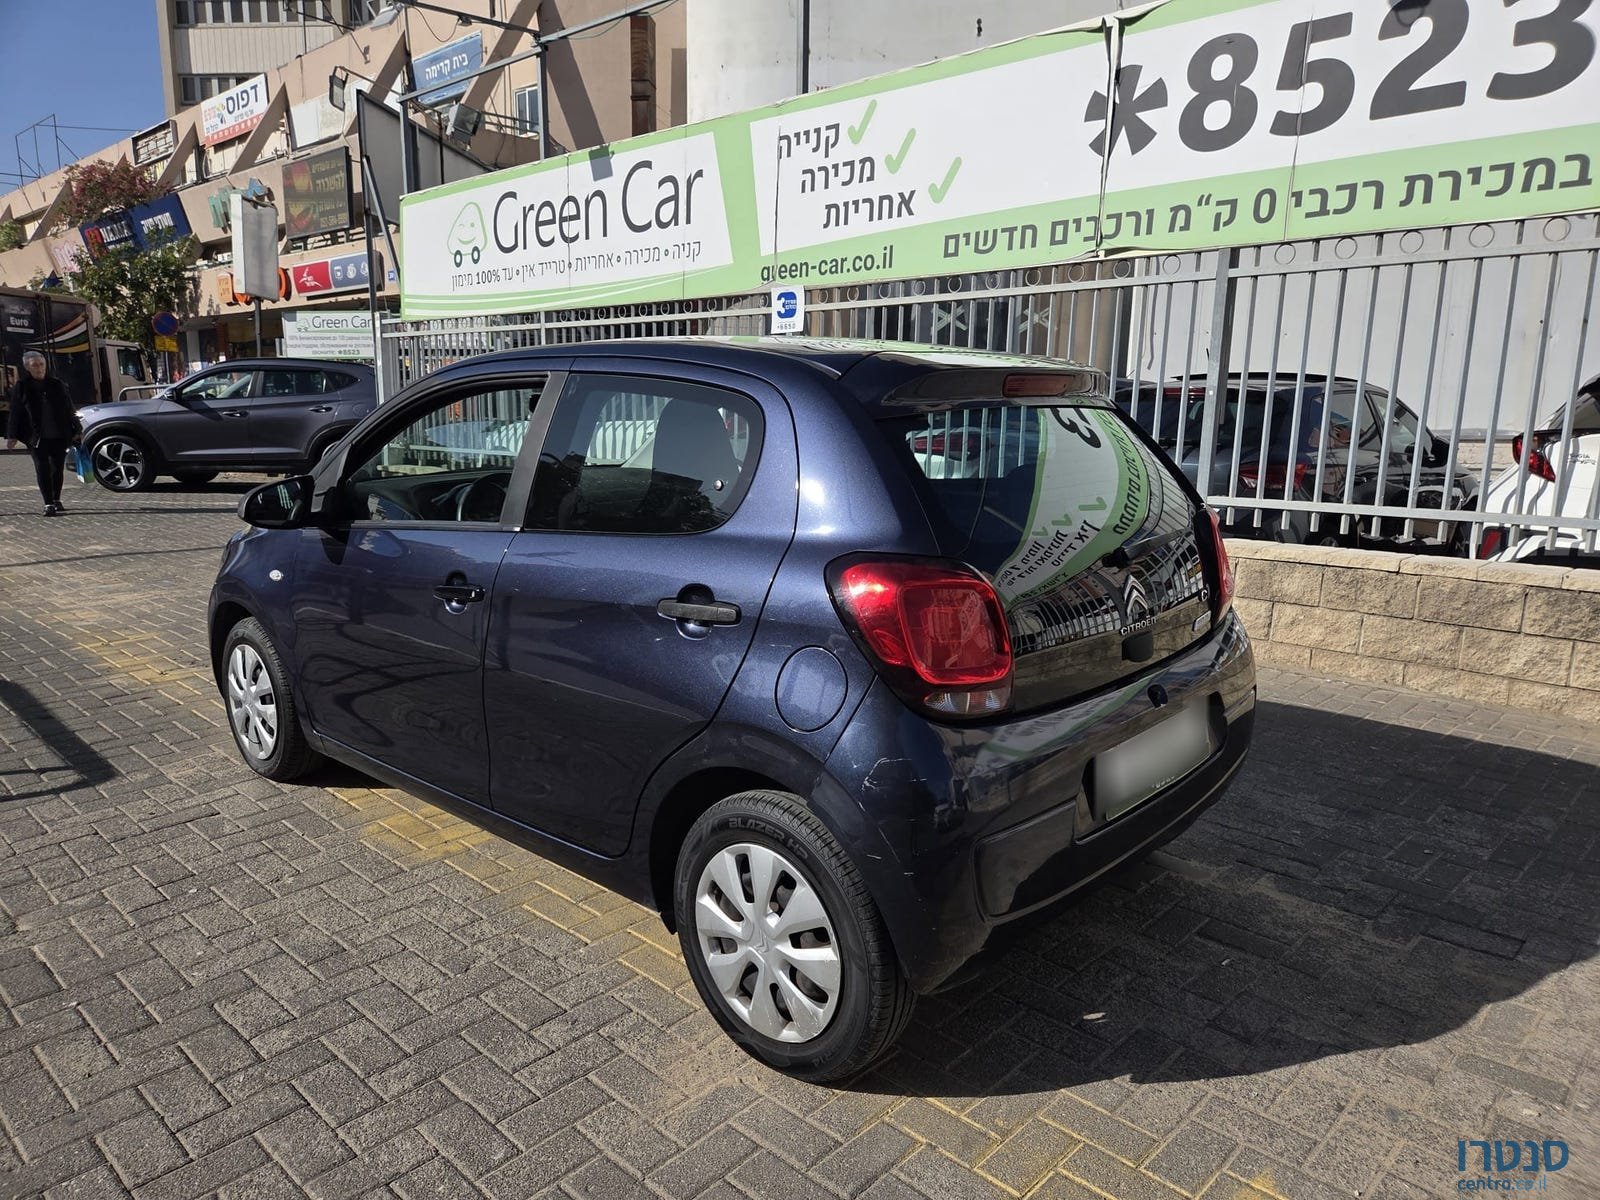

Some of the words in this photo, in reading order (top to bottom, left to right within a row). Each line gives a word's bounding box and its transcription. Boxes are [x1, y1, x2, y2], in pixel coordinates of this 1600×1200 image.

[453, 53, 469, 69] בית
[226, 84, 258, 115] דפוס
[778, 122, 840, 160] קנייה
[801, 156, 876, 193] מכירה
[1399, 153, 1593, 207] במכירת
[493, 189, 608, 254] Green
[621, 160, 704, 233] Car
[823, 189, 917, 229] אחריות
[1252, 188, 1277, 224] 0
[1290, 179, 1385, 219] רכבי
[1049, 208, 1155, 247] ורכבים
[943, 223, 1038, 258] חדשים
[575, 252, 614, 272] אחריות
[624, 246, 661, 265] מכירה
[672, 241, 701, 262] קניה
[476, 269, 501, 285] 100%
[502, 266, 514, 281] עד
[521, 263, 535, 282] אין
[538, 259, 566, 275] טרייד
[452, 273, 474, 292] מימון
[10, 316, 29, 327] Euro
[312, 315, 349, 329] Green
[351, 315, 373, 329] Car
[1120, 616, 1157, 636] CITROËN
[728, 817, 785, 841] BLAZER
